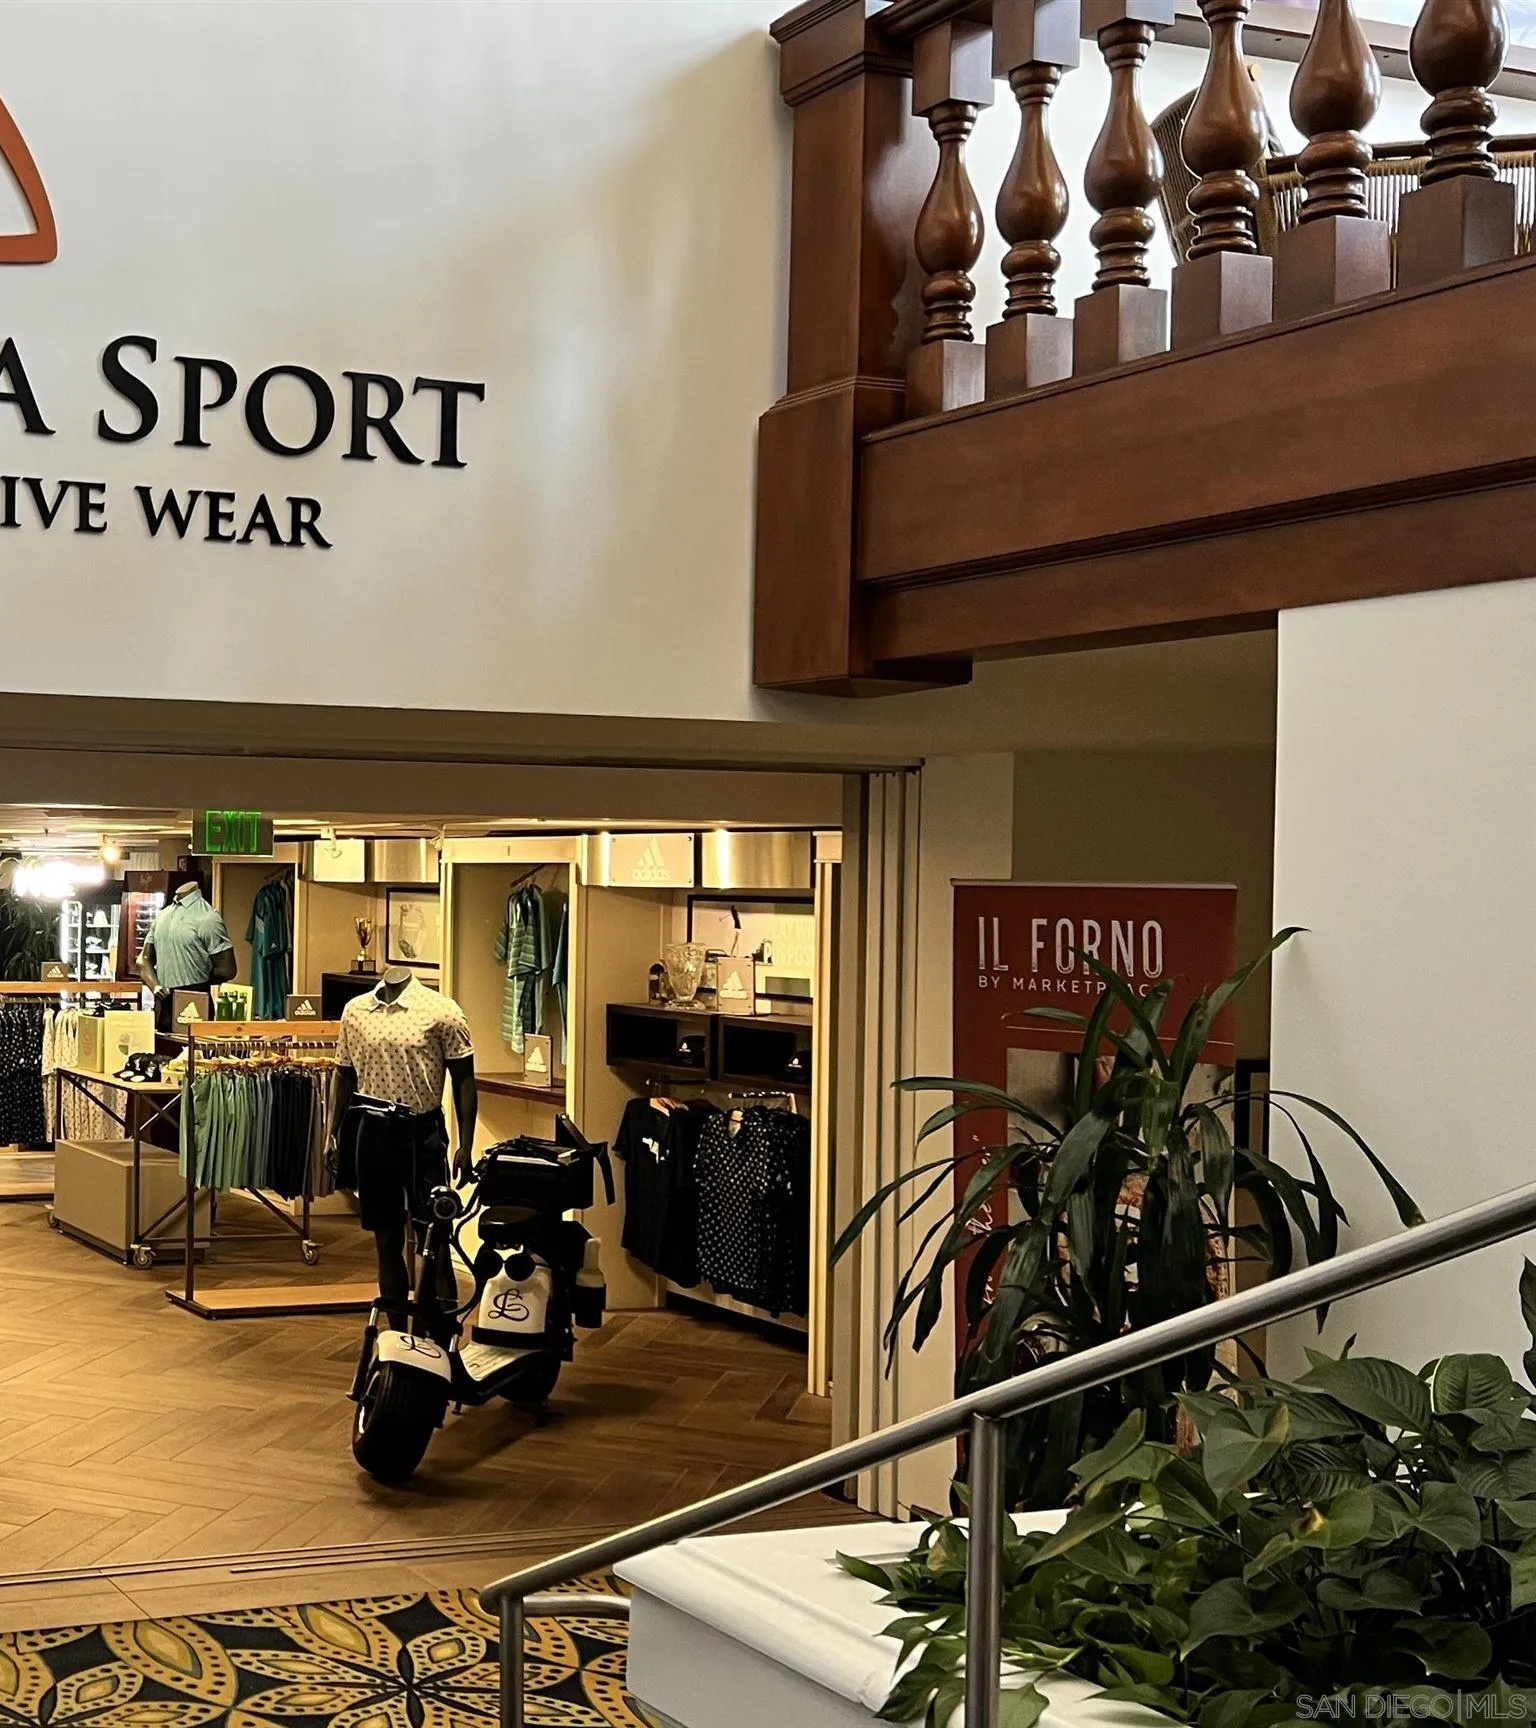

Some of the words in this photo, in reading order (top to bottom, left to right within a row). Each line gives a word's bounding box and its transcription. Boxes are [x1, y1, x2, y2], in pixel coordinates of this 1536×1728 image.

[97, 335, 486, 469] SPORT
[134, 486, 333, 548] WEAR
[206, 810, 262, 852] EXIT
[978, 916, 1009, 971] IL
[1031, 918, 1163, 979] FORNO
[979, 975, 999, 989] BY
